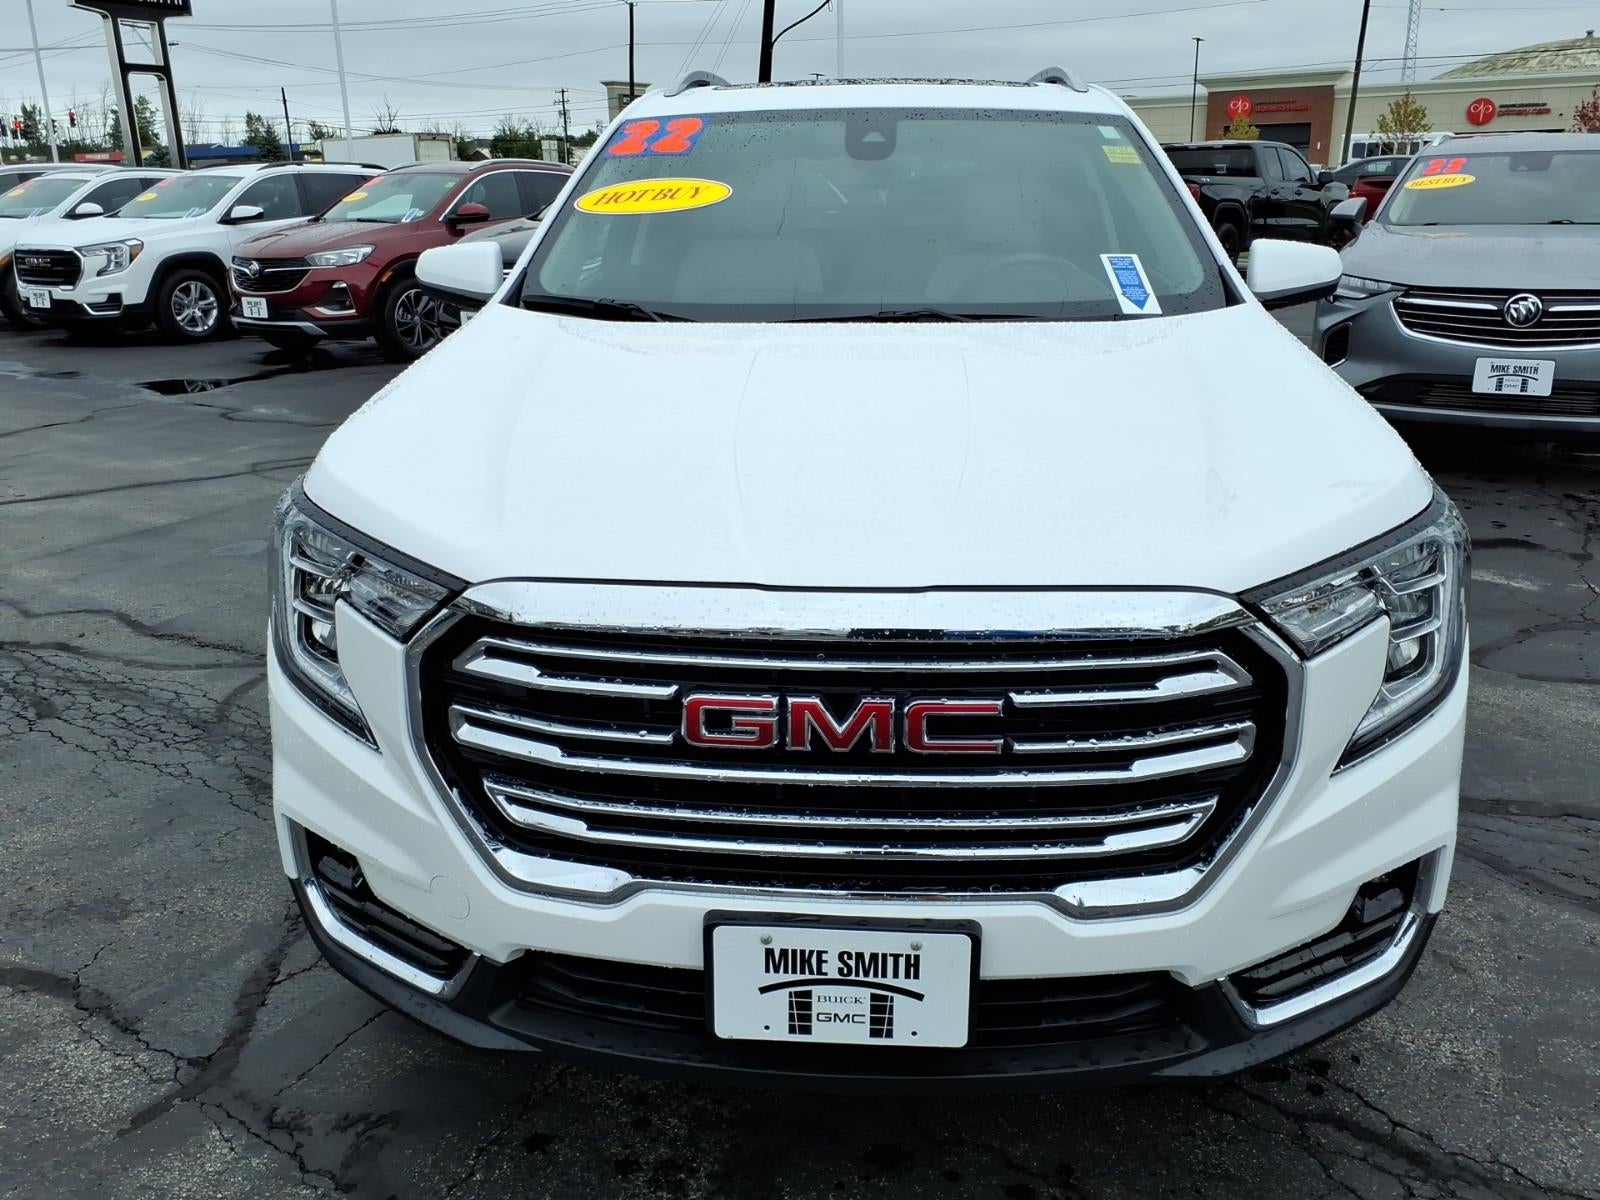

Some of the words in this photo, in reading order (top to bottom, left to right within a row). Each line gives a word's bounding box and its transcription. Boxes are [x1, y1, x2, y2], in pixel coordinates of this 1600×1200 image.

[607, 117, 703, 155] 22
[593, 189, 651, 206] HOT
[650, 186, 710, 201] BUY
[1490, 364, 1511, 374] MIKE
[1512, 365, 1539, 375] SMITH
[681, 692, 1004, 754] GMC
[764, 947, 829, 976] MIKE
[837, 950, 921, 980] SMITH
[816, 994, 866, 1005] BUICK
[816, 1011, 867, 1024] GMC
